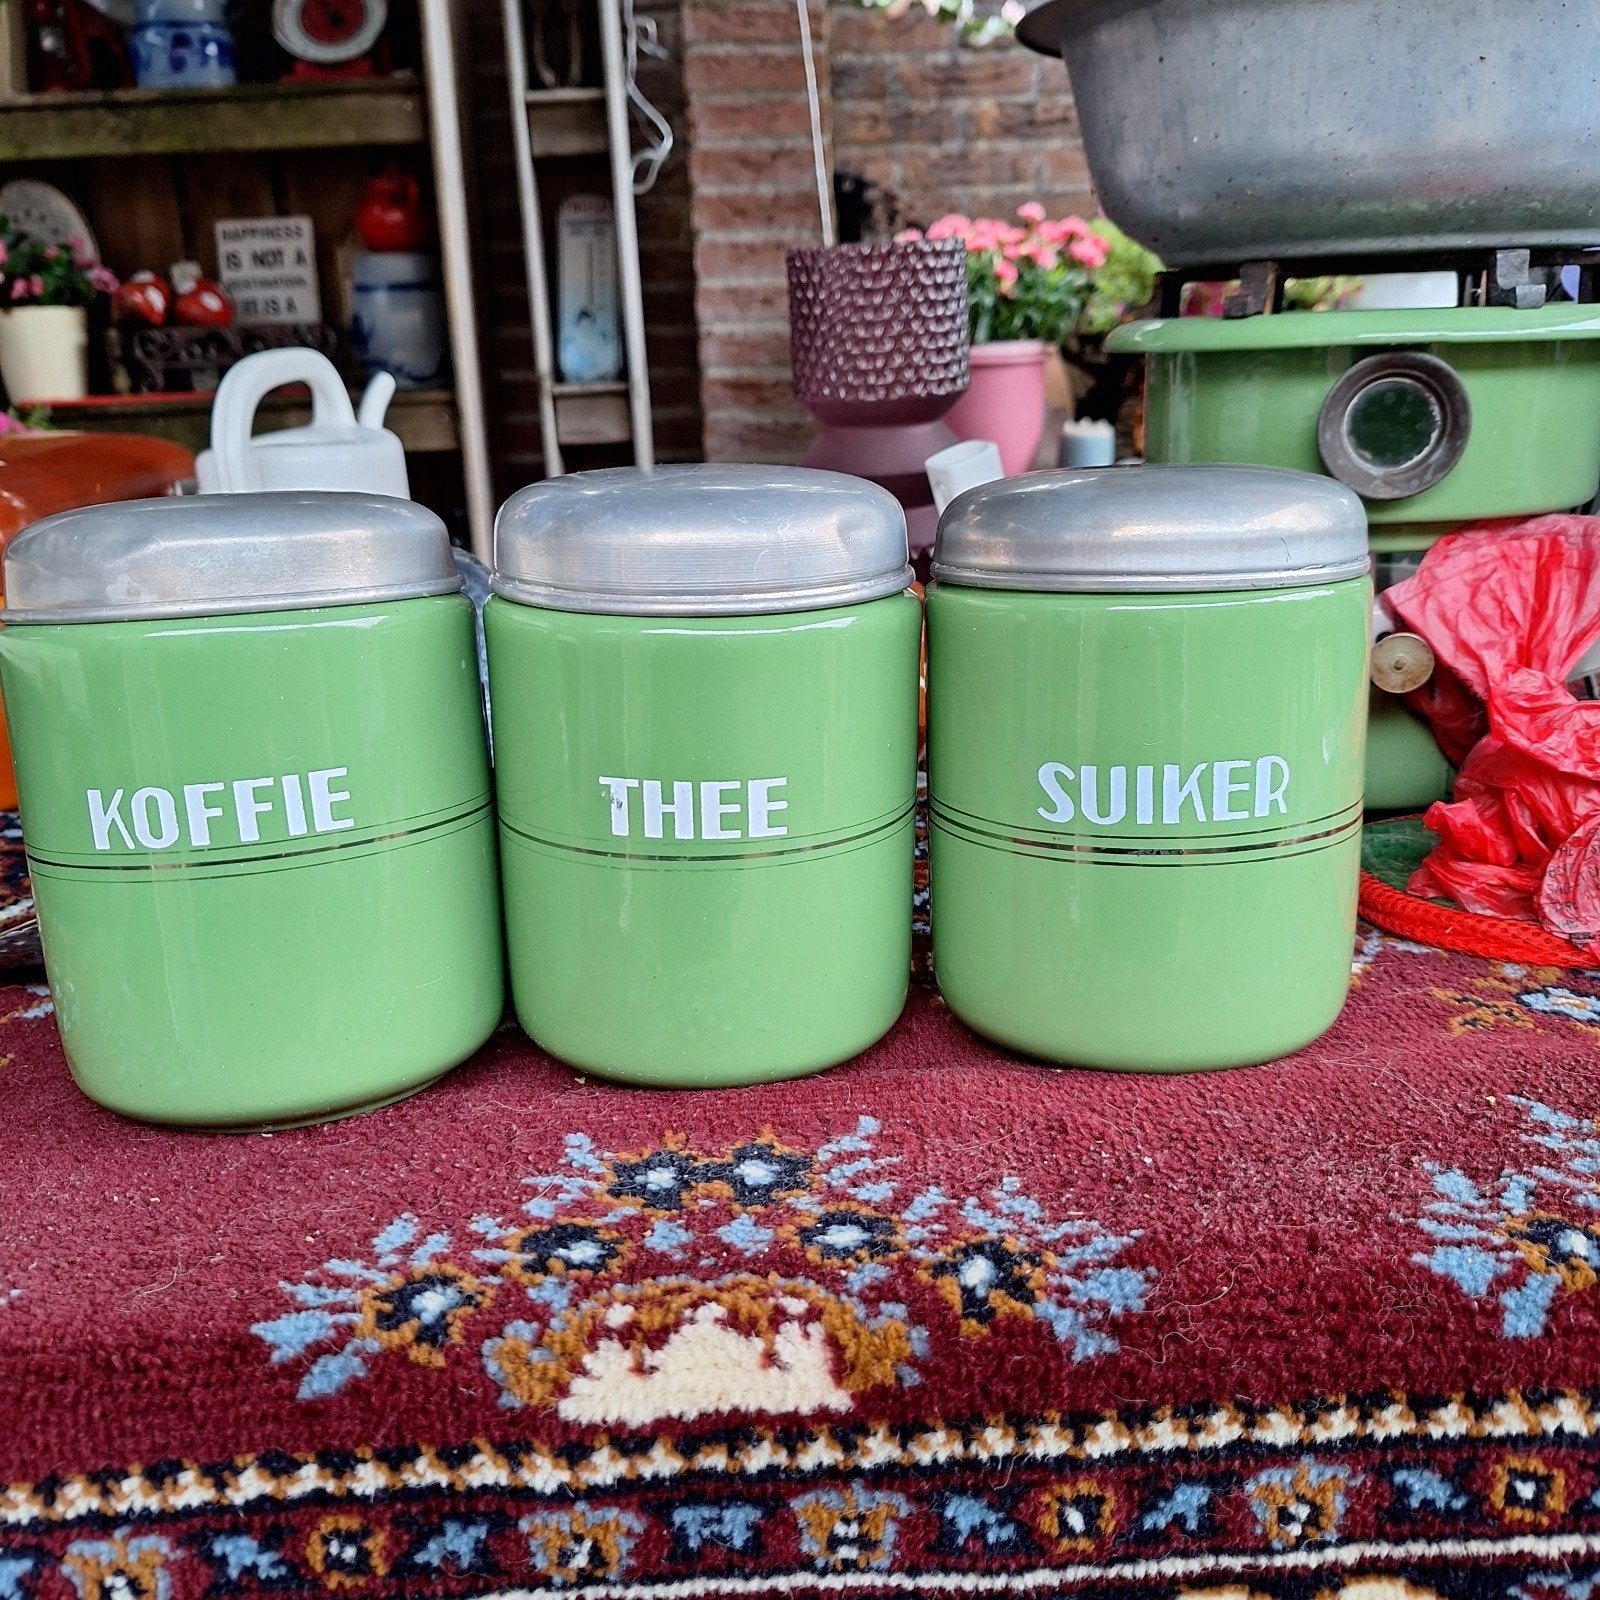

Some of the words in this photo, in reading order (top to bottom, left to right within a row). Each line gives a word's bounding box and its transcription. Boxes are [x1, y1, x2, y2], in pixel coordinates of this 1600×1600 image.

[225, 250, 242, 269] IS
[251, 248, 284, 267] NOT
[295, 247, 307, 266] A
[286, 296, 299, 314] A
[86, 766, 355, 852] KOFFIE
[598, 775, 790, 840] THEE
[1036, 755, 1291, 825] SUIKER
